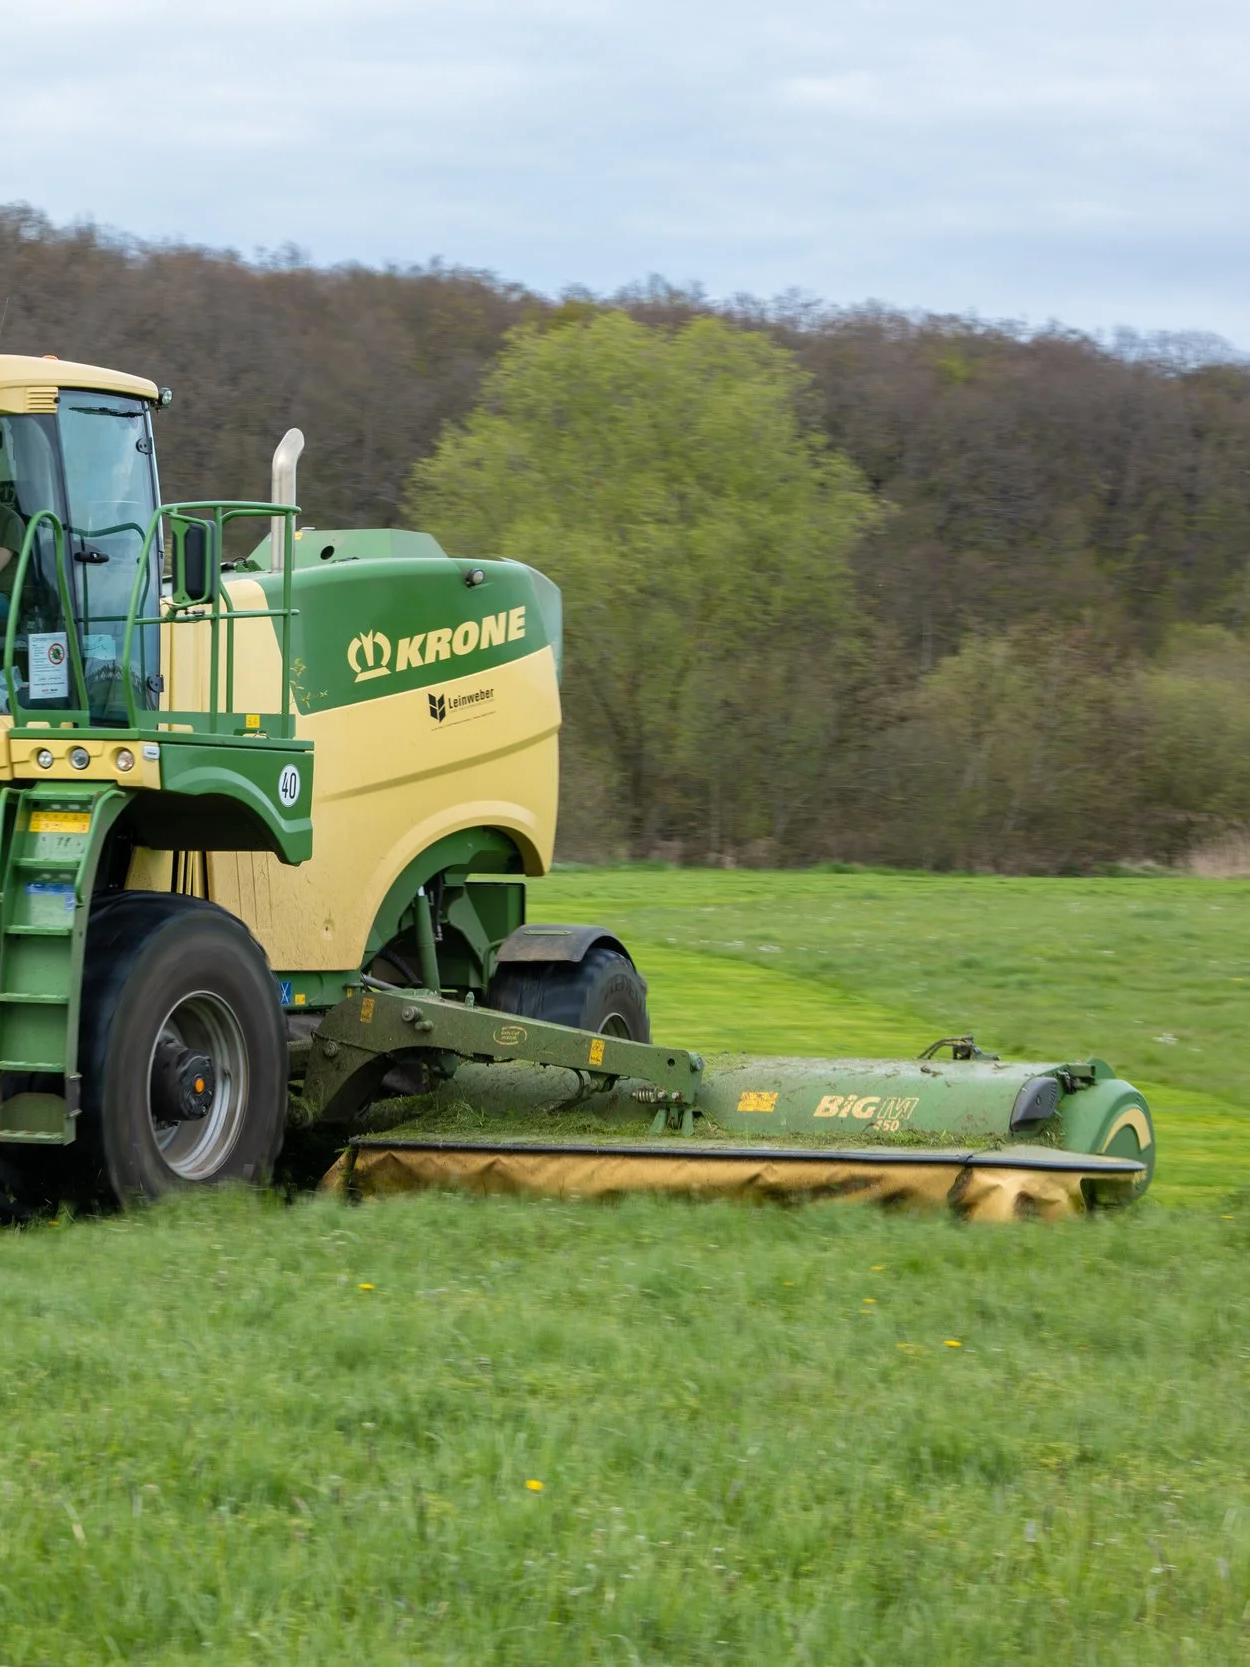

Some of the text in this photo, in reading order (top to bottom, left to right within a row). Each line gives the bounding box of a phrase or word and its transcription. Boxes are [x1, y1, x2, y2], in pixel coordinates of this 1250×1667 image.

[395, 605, 526, 672] KRONE
[448, 688, 494, 709] Leinweber
[281, 772, 297, 799] 40
